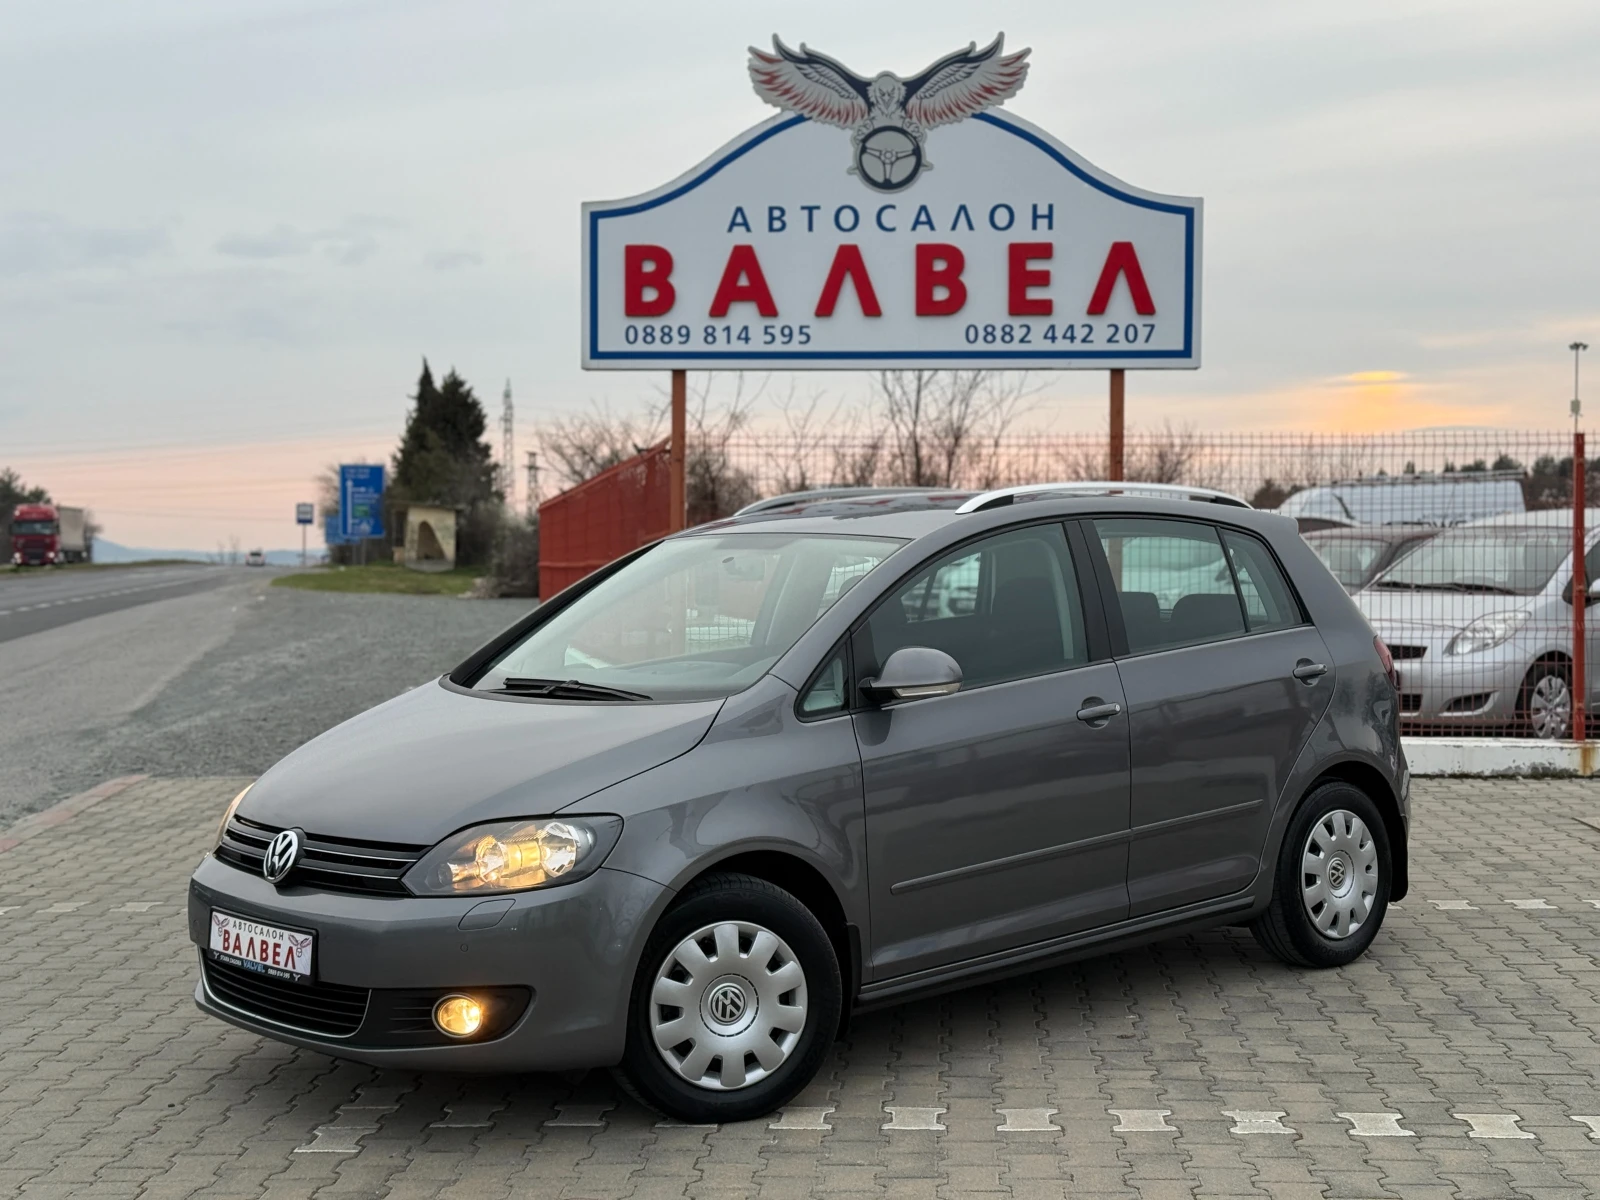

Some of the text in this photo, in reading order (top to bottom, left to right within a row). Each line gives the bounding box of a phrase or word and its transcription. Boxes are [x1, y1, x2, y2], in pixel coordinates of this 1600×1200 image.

[727, 203, 1055, 233] АВТОСАЛОН
[623, 240, 1157, 320] ВАЛВЕЛ
[625, 323, 812, 345] 0889 814 595
[965, 323, 1156, 344] 0882 442 207
[232, 920, 284, 941] АВТОСАЛОН
[222, 929, 296, 970] ВАЛВЕЛ
[243, 959, 265, 973] VALVEL
